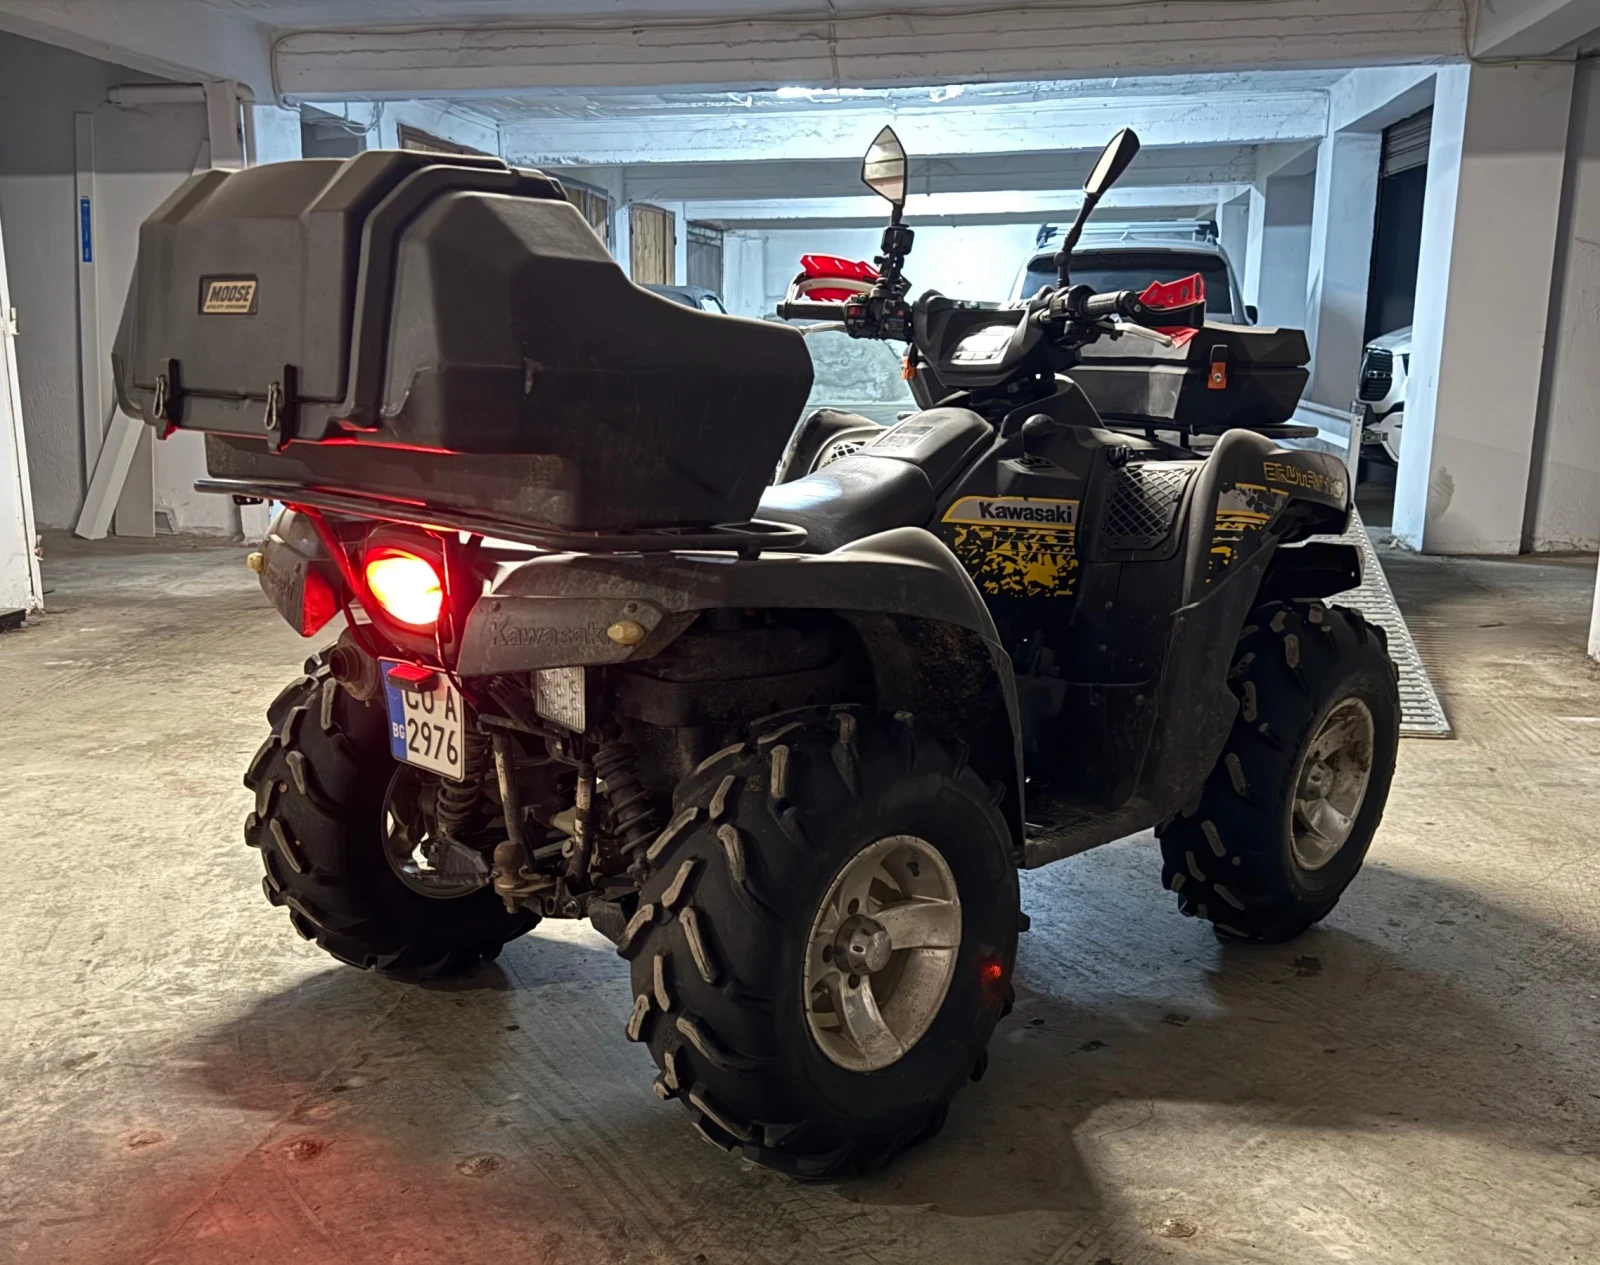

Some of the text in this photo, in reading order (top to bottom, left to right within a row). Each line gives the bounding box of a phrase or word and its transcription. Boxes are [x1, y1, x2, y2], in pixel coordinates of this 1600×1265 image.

[209, 285, 252, 302] MOOSE
[979, 501, 1072, 524] Kawasaki
[445, 685, 458, 723] A
[392, 722, 405, 739] BG
[407, 717, 458, 765] 2976
